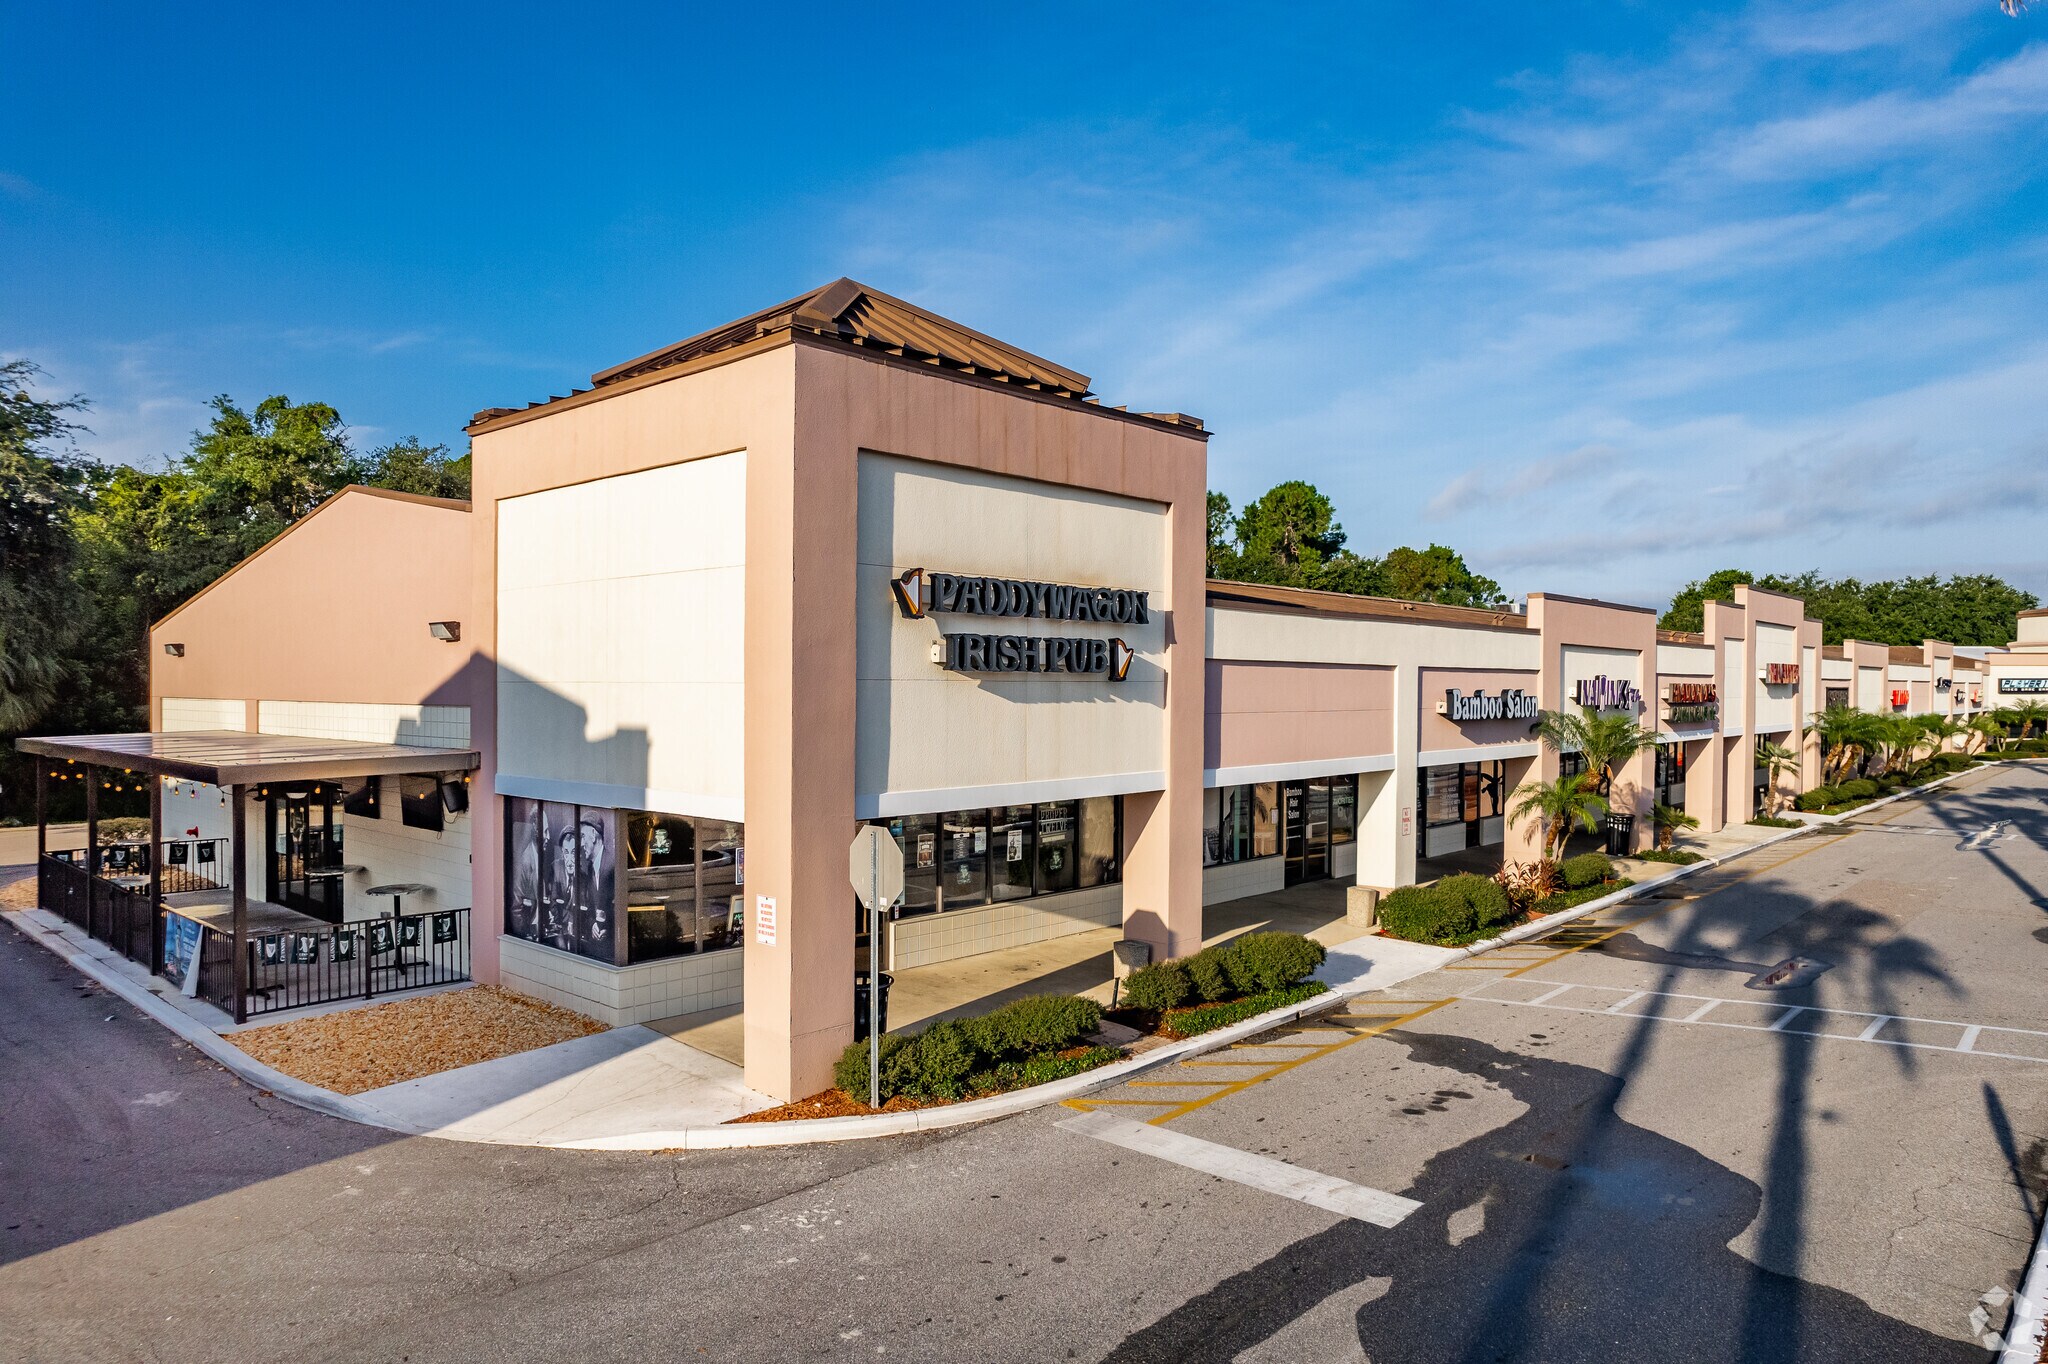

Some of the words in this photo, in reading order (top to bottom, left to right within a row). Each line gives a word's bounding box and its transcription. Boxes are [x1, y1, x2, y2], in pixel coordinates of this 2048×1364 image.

[943, 633, 1042, 672] IRISH
[1043, 637, 1108, 673] PUB
[1450, 689, 1503, 720] Bamboo
[1505, 689, 1538, 718] Salon
[1286, 787, 1302, 797] Bamboo
[1289, 798, 1298, 807] Hair
[1288, 810, 1300, 819] Salon
[1041, 821, 1067, 834] TWELVE
